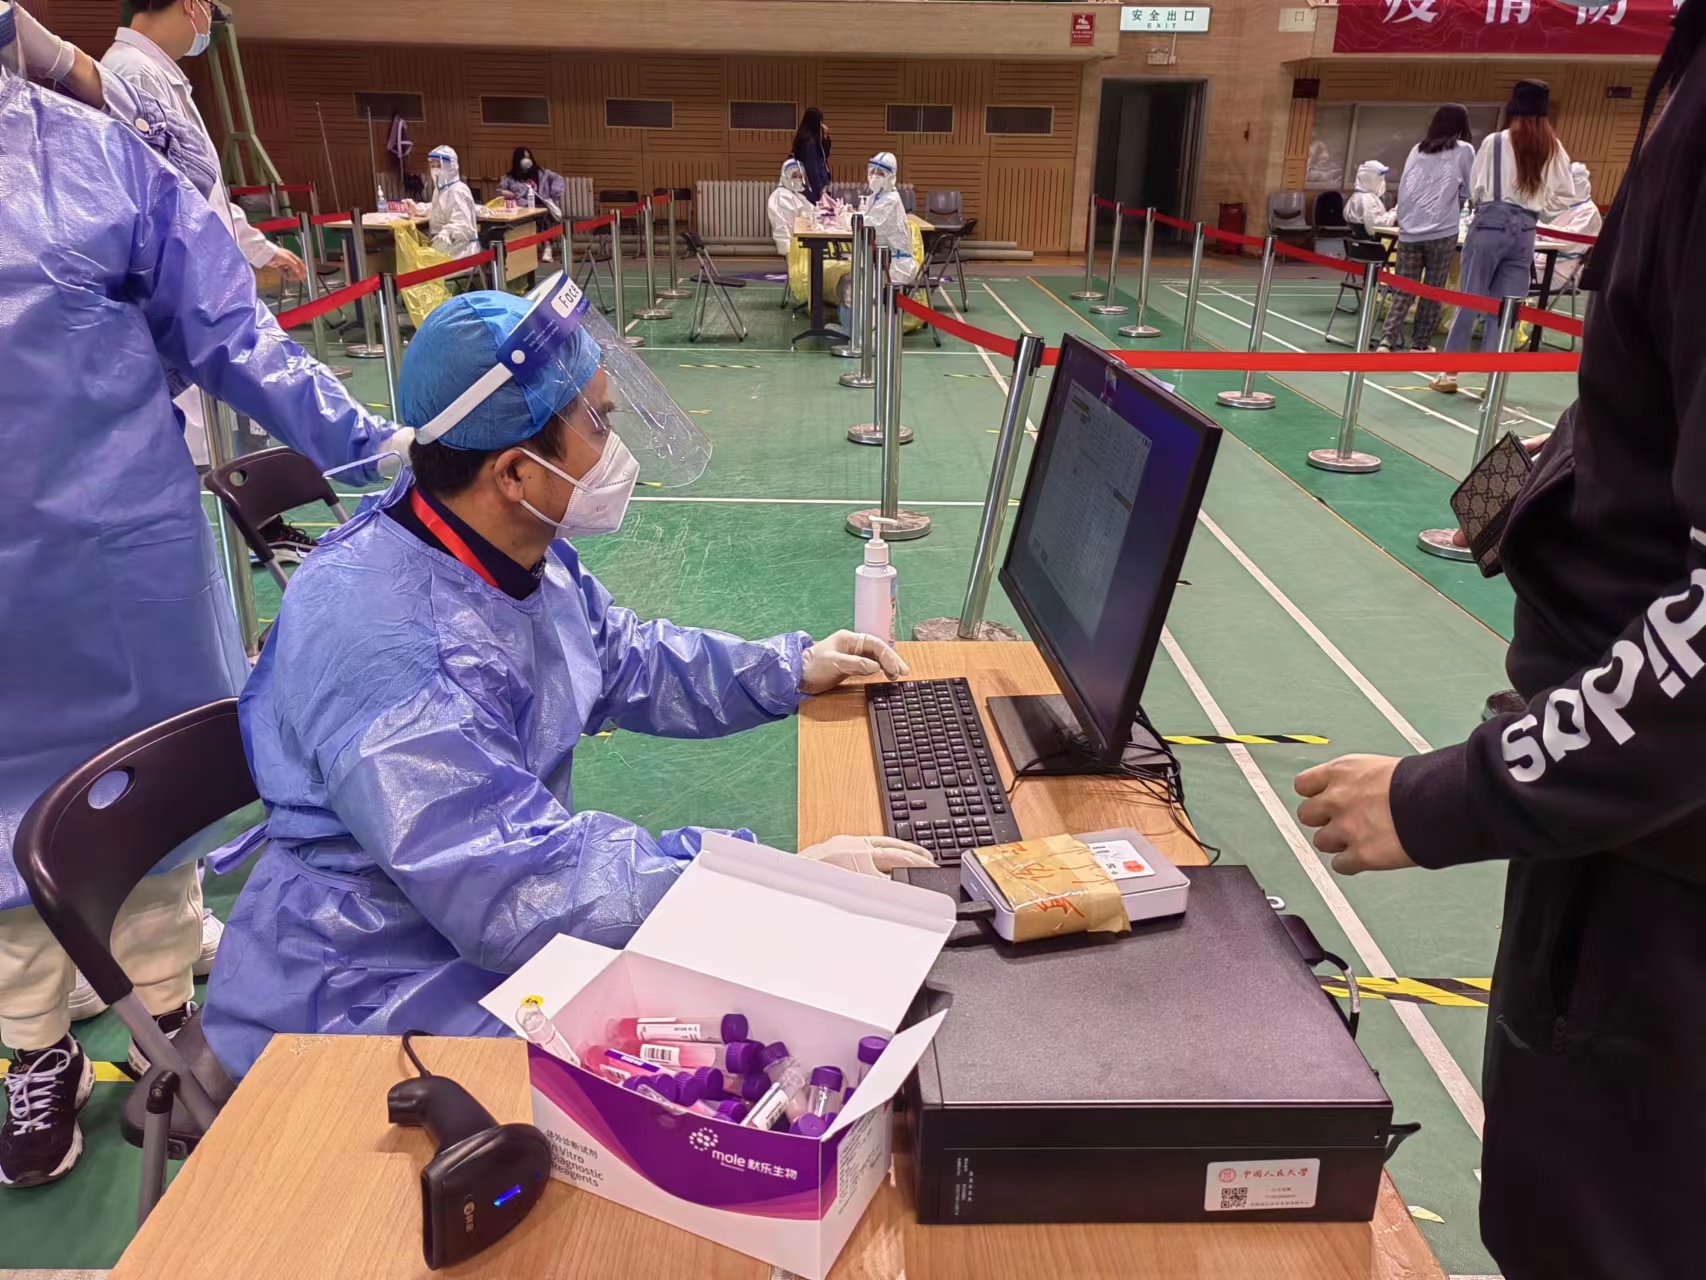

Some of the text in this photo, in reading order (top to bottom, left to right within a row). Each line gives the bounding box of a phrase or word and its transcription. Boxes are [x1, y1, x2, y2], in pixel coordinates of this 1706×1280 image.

[1132, 9, 1195, 21] 安全出口
[558, 284, 580, 309] Face
[1501, 526, 1706, 783] didas
[559, 1145, 585, 1164] Vitro
[711, 1149, 746, 1168] mole
[747, 1158, 798, 1181] 默乐生物
[1243, 1167, 1308, 1179] 中国人民大学
